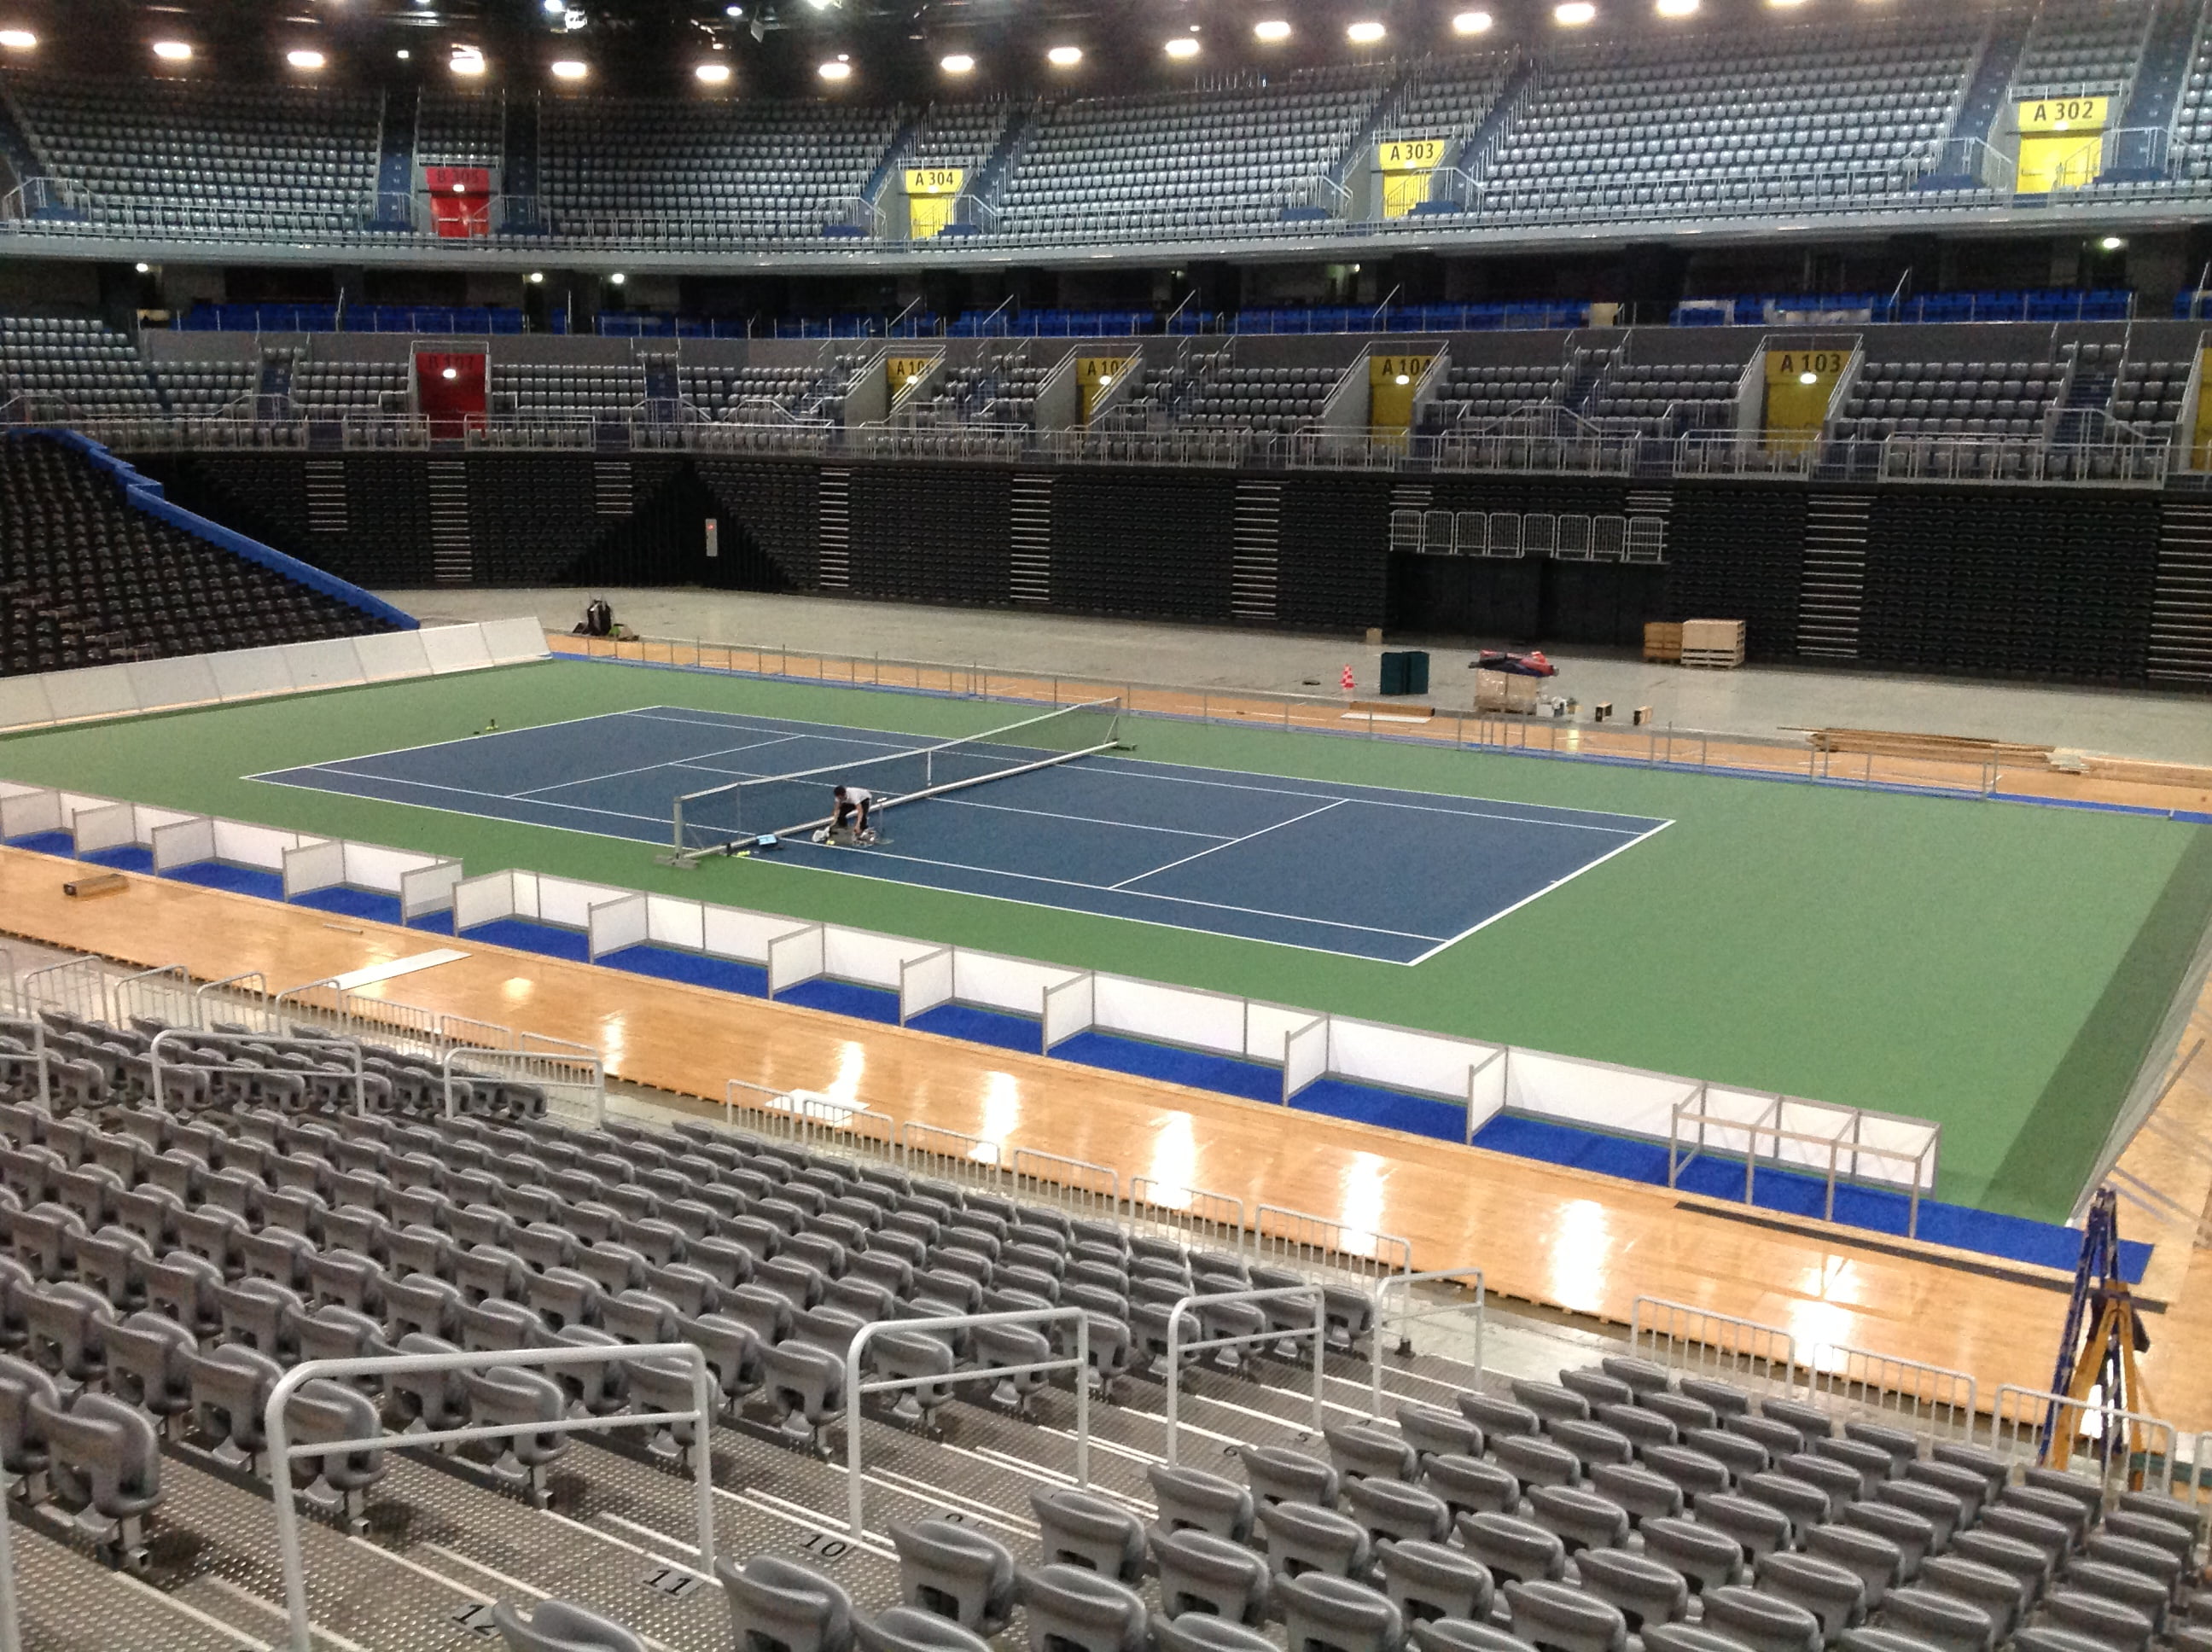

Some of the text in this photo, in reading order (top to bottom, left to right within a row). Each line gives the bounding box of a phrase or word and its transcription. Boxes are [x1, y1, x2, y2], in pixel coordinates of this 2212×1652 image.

[2034, 101, 2093, 121] A 302
[1390, 143, 1433, 160] A 303
[916, 172, 953, 186] A 304
[897, 360, 905, 375] A
[1087, 360, 1126, 375] A 10
[1382, 359, 1394, 375] A
[1780, 353, 1841, 373] A 103
[800, 1533, 847, 1557] 10
[643, 1569, 692, 1597] 11
